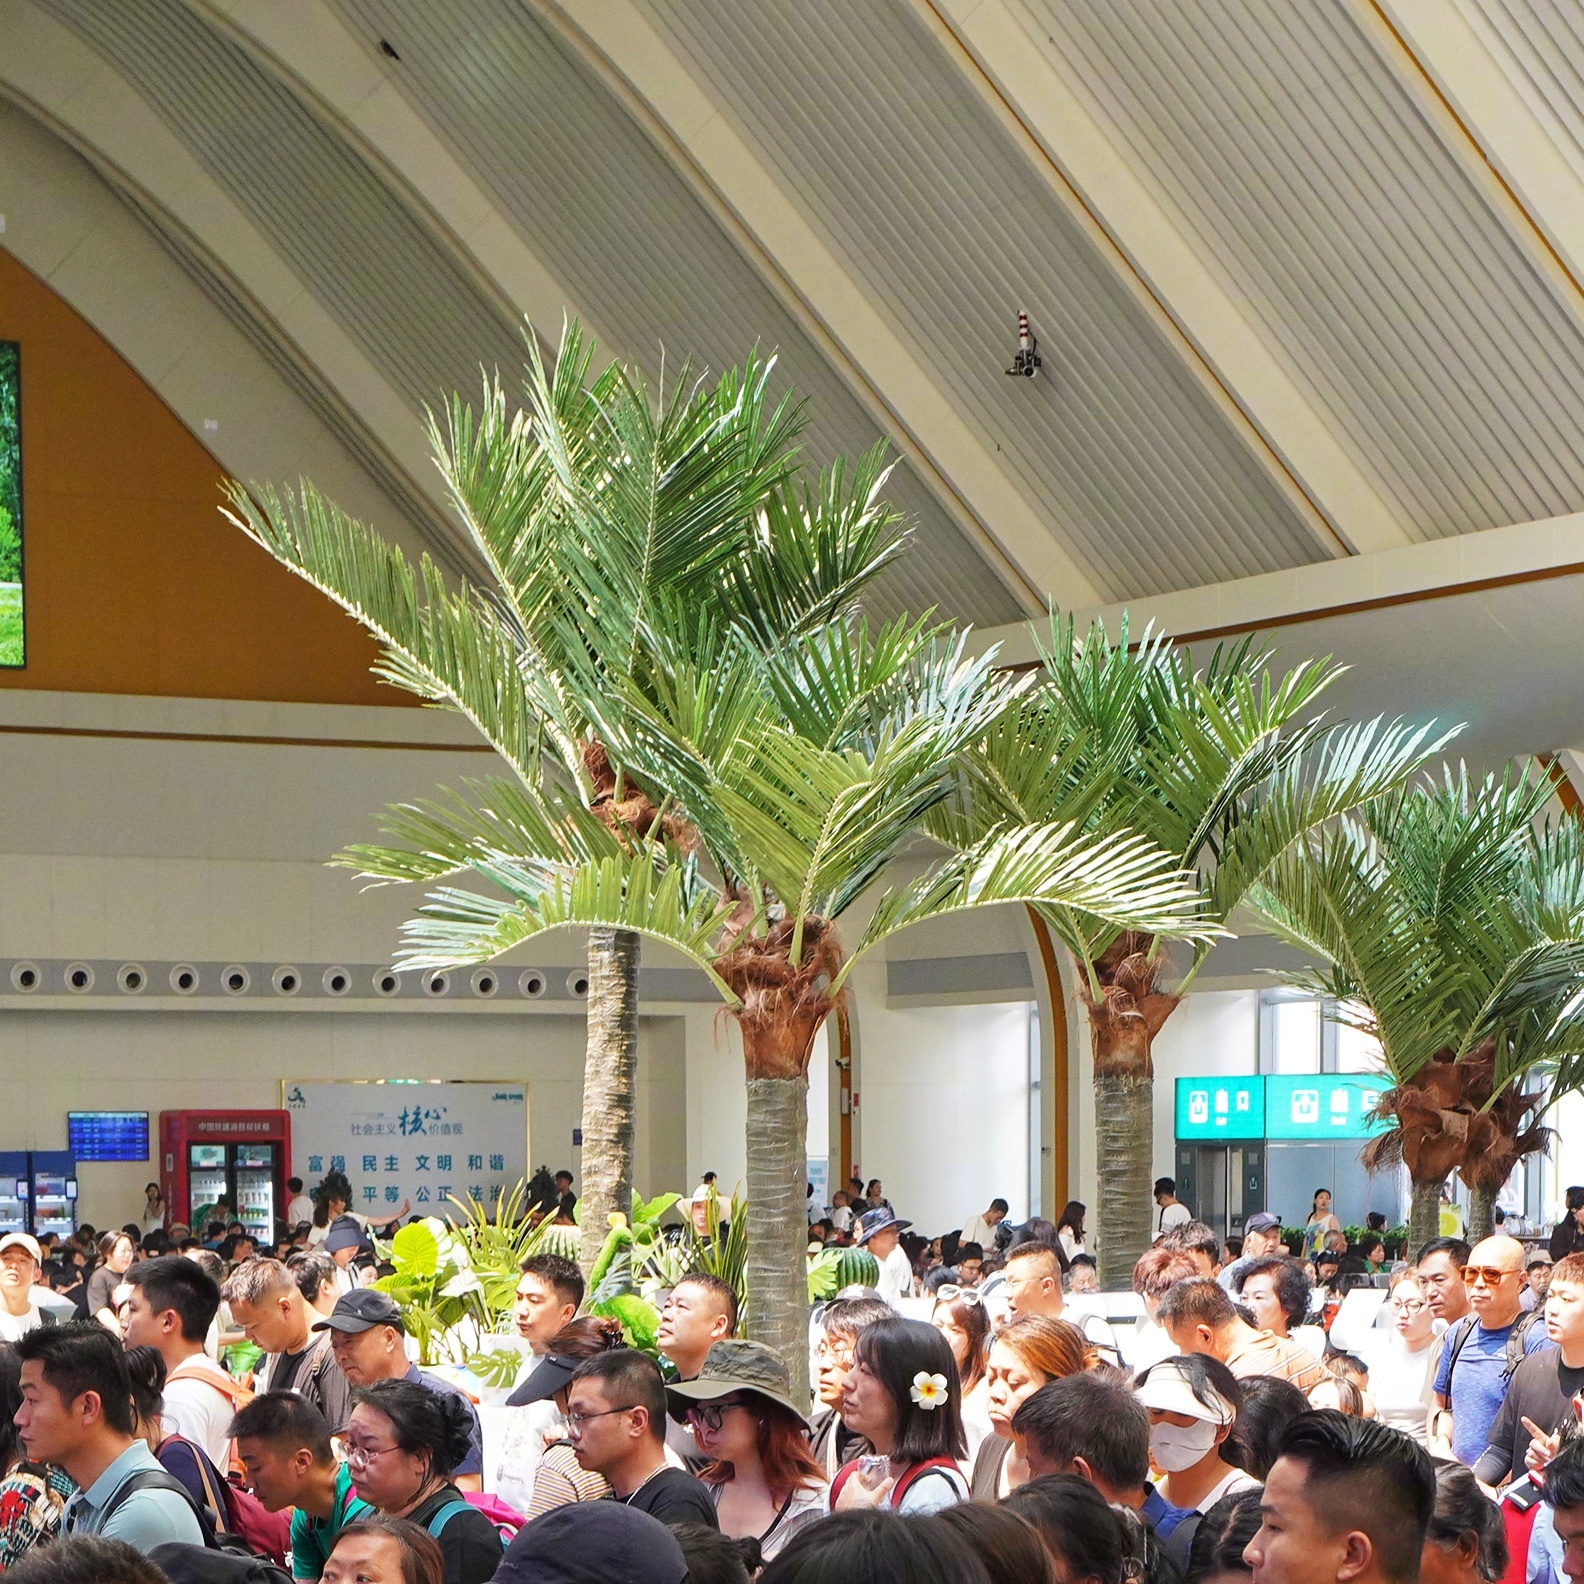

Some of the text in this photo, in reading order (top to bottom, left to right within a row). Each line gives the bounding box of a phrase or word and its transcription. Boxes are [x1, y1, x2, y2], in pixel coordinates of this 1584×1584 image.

[362, 1154, 400, 1172] 民主
[415, 1154, 452, 1172] 文明
[467, 1154, 504, 1172] 和谐
[362, 1185, 400, 1204] 平等
